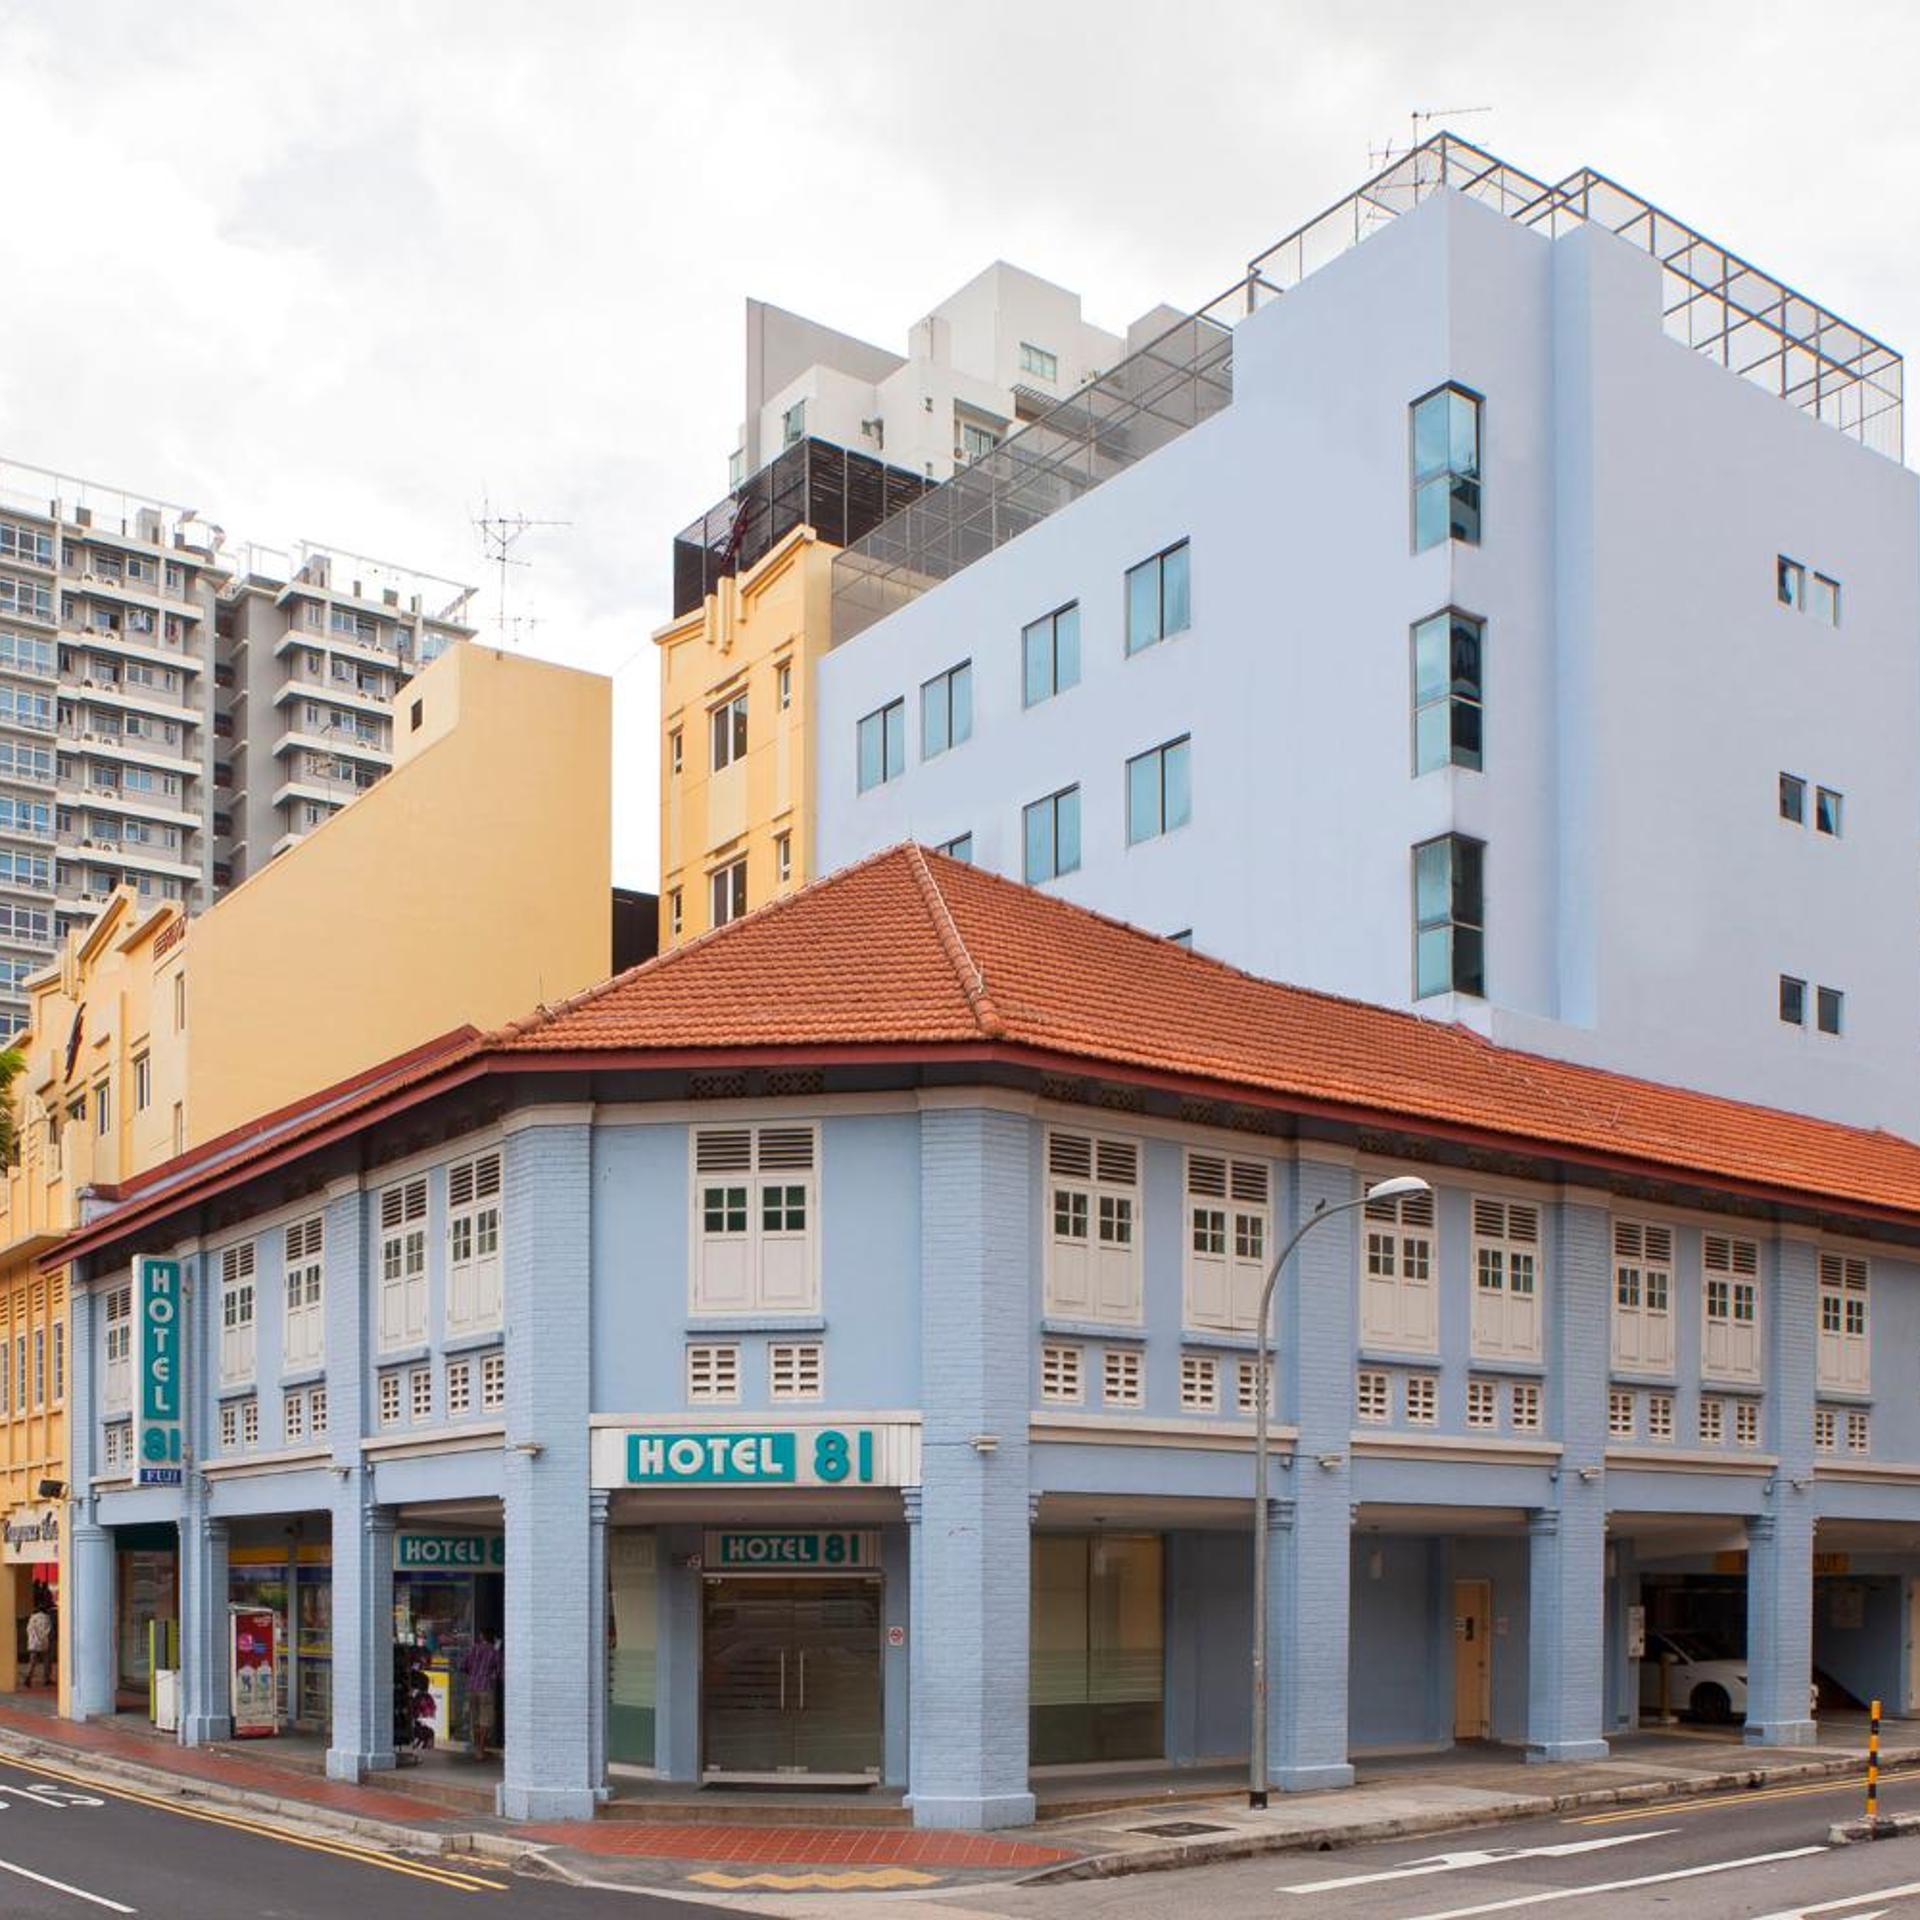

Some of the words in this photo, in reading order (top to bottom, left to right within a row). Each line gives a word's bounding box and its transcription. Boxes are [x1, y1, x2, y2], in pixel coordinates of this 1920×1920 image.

[149, 1268, 174, 1411] HOTEL
[143, 1427, 181, 1462] 81
[638, 1438, 784, 1475] HOTEL
[814, 1430, 873, 1483] 81
[406, 1539, 481, 1561] HOTEL
[490, 1535, 505, 1565] 8
[729, 1538, 812, 1560] HOTEL
[825, 1534, 859, 1563] 81
